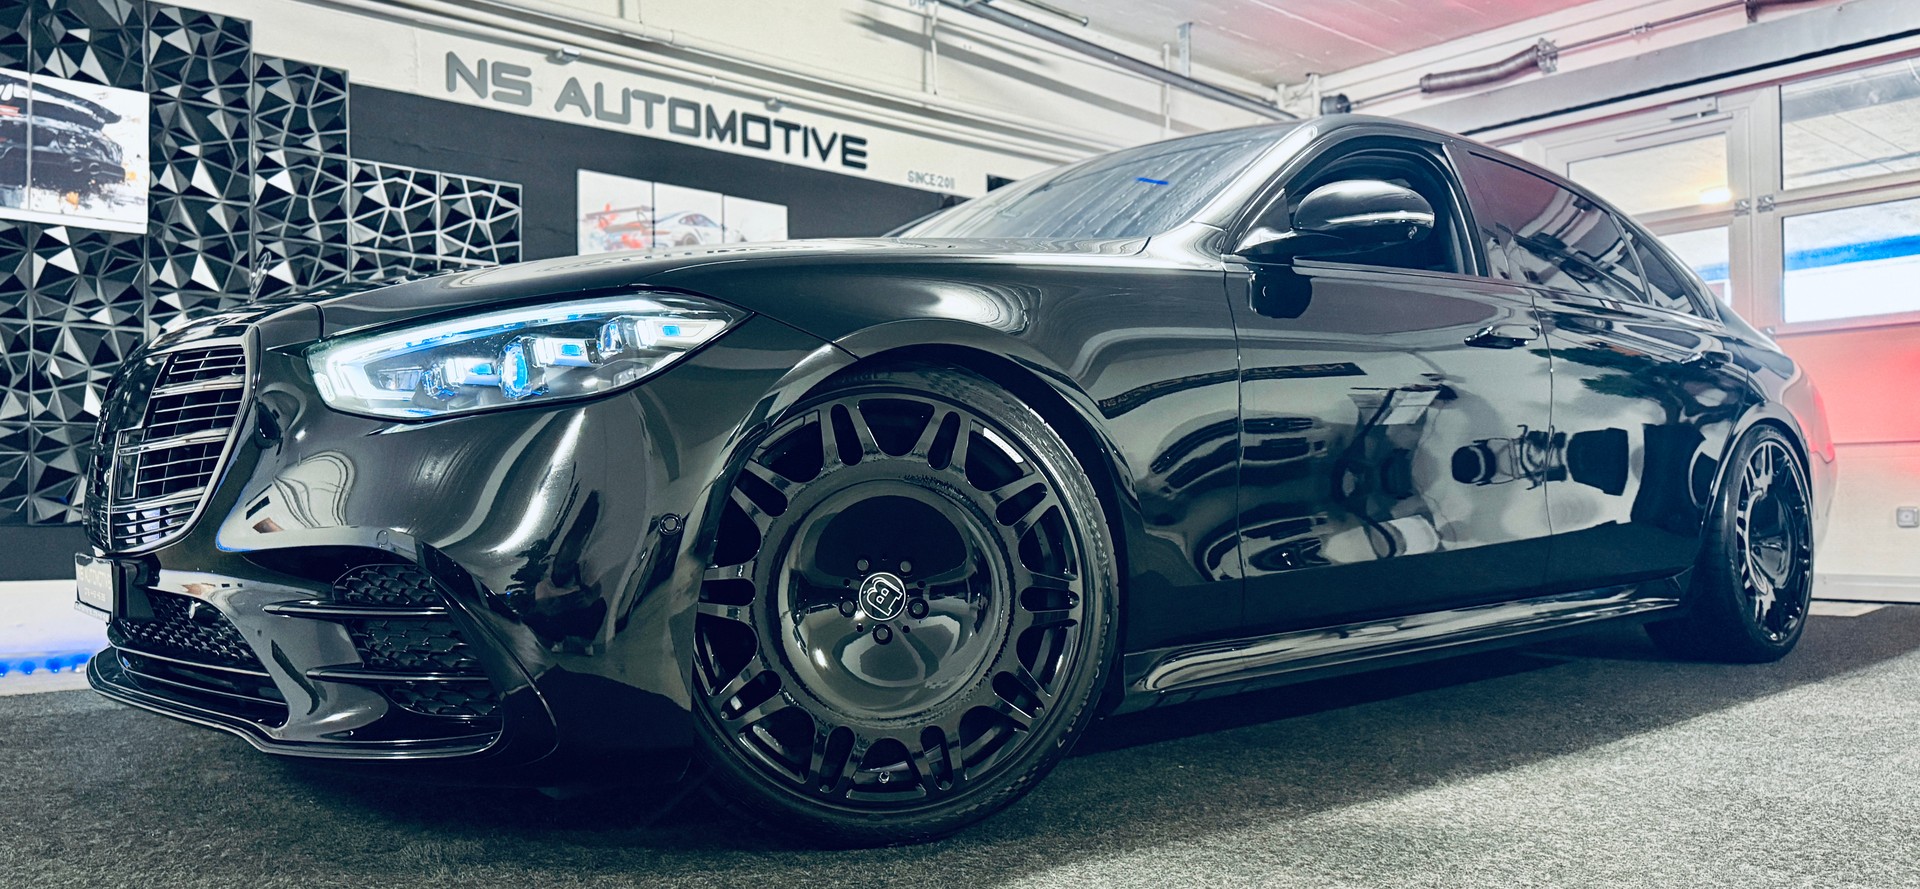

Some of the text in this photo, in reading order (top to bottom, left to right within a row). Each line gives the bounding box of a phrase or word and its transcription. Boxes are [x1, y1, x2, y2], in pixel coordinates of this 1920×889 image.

[446, 51, 868, 170] NS AUTOMOTIVE
[907, 170, 936, 187] SINCE
